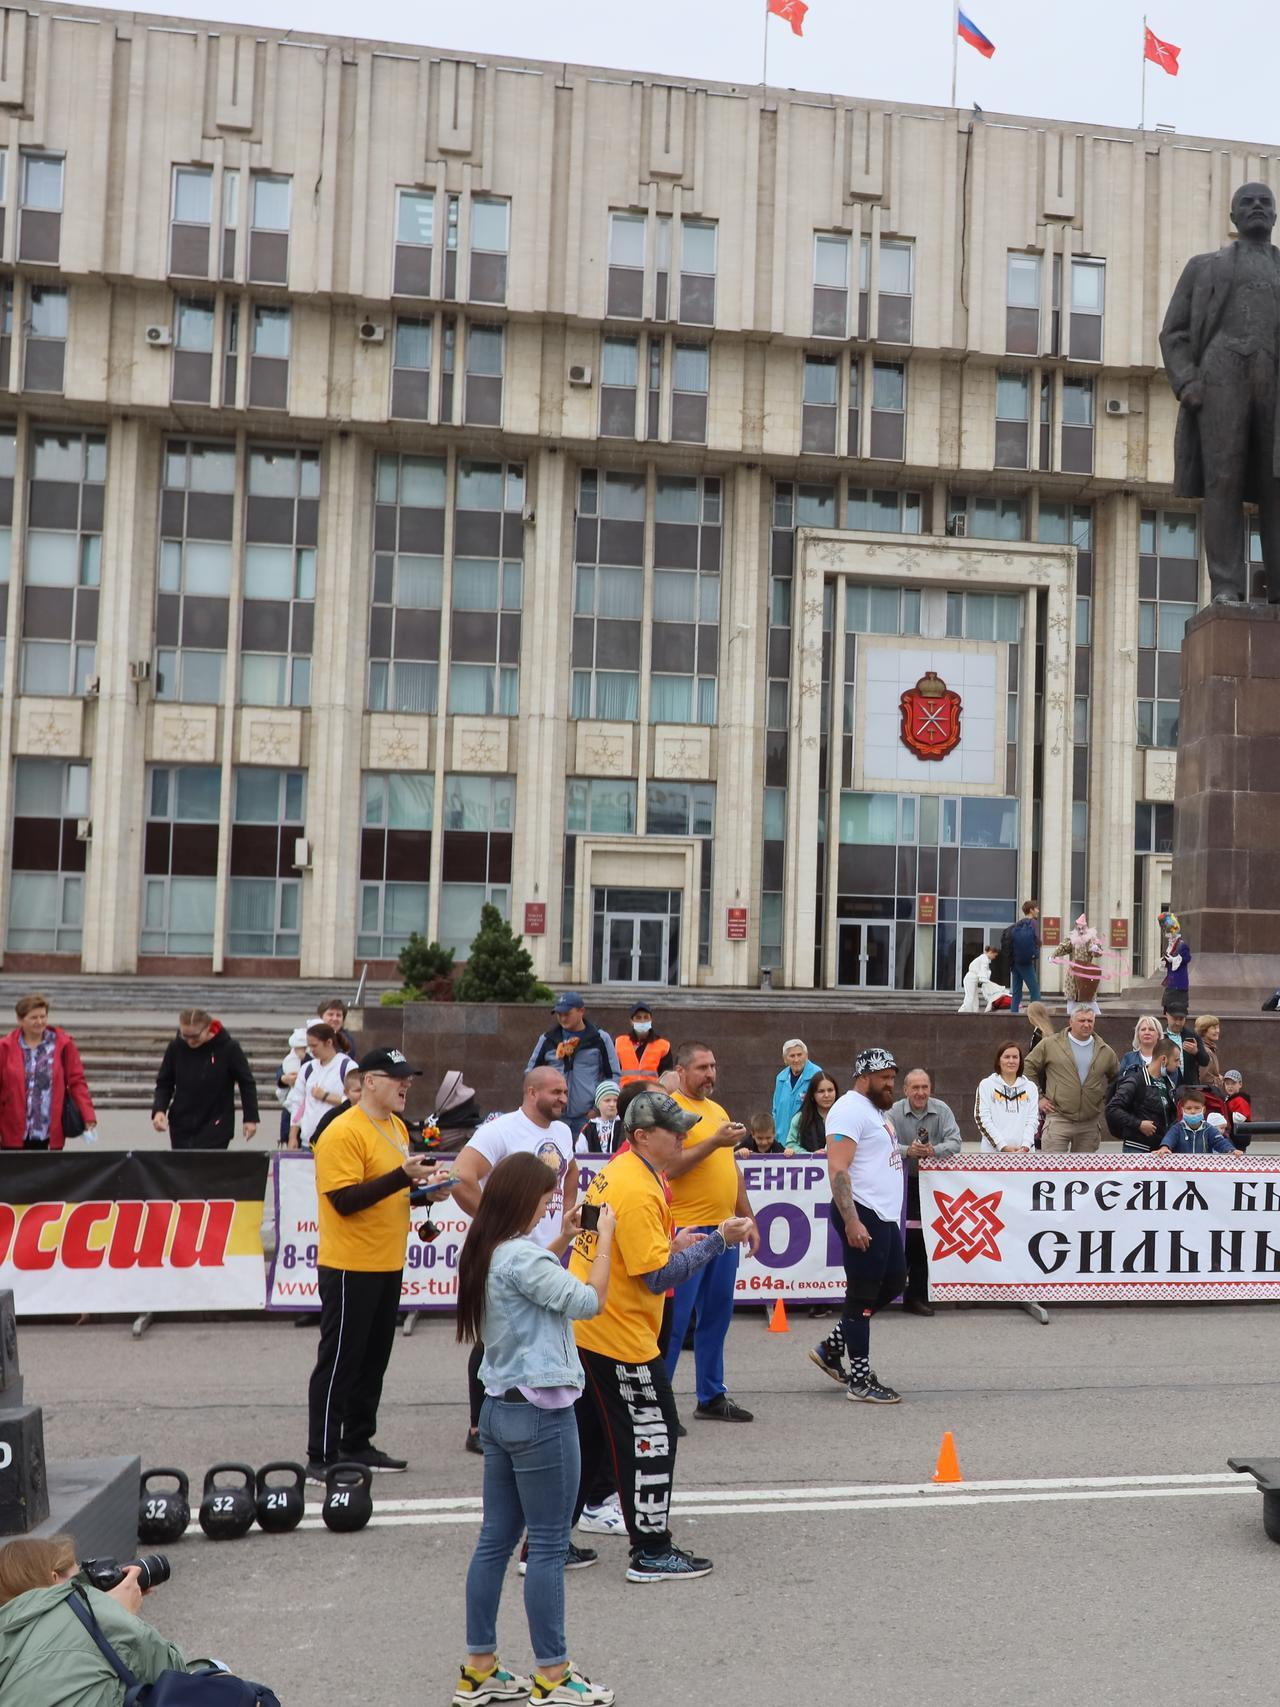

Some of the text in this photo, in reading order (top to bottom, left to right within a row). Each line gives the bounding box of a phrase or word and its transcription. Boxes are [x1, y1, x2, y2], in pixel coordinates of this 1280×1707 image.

[744, 1167, 825, 1190] ЕНТР
[798, 1281, 826, 1291] вход
[213, 1496, 234, 1512] 32
[267, 1493, 287, 1509] 24
[330, 1492, 349, 1508] 24
[634, 1470, 670, 1534] GET
[145, 1499, 167, 1519] 32
